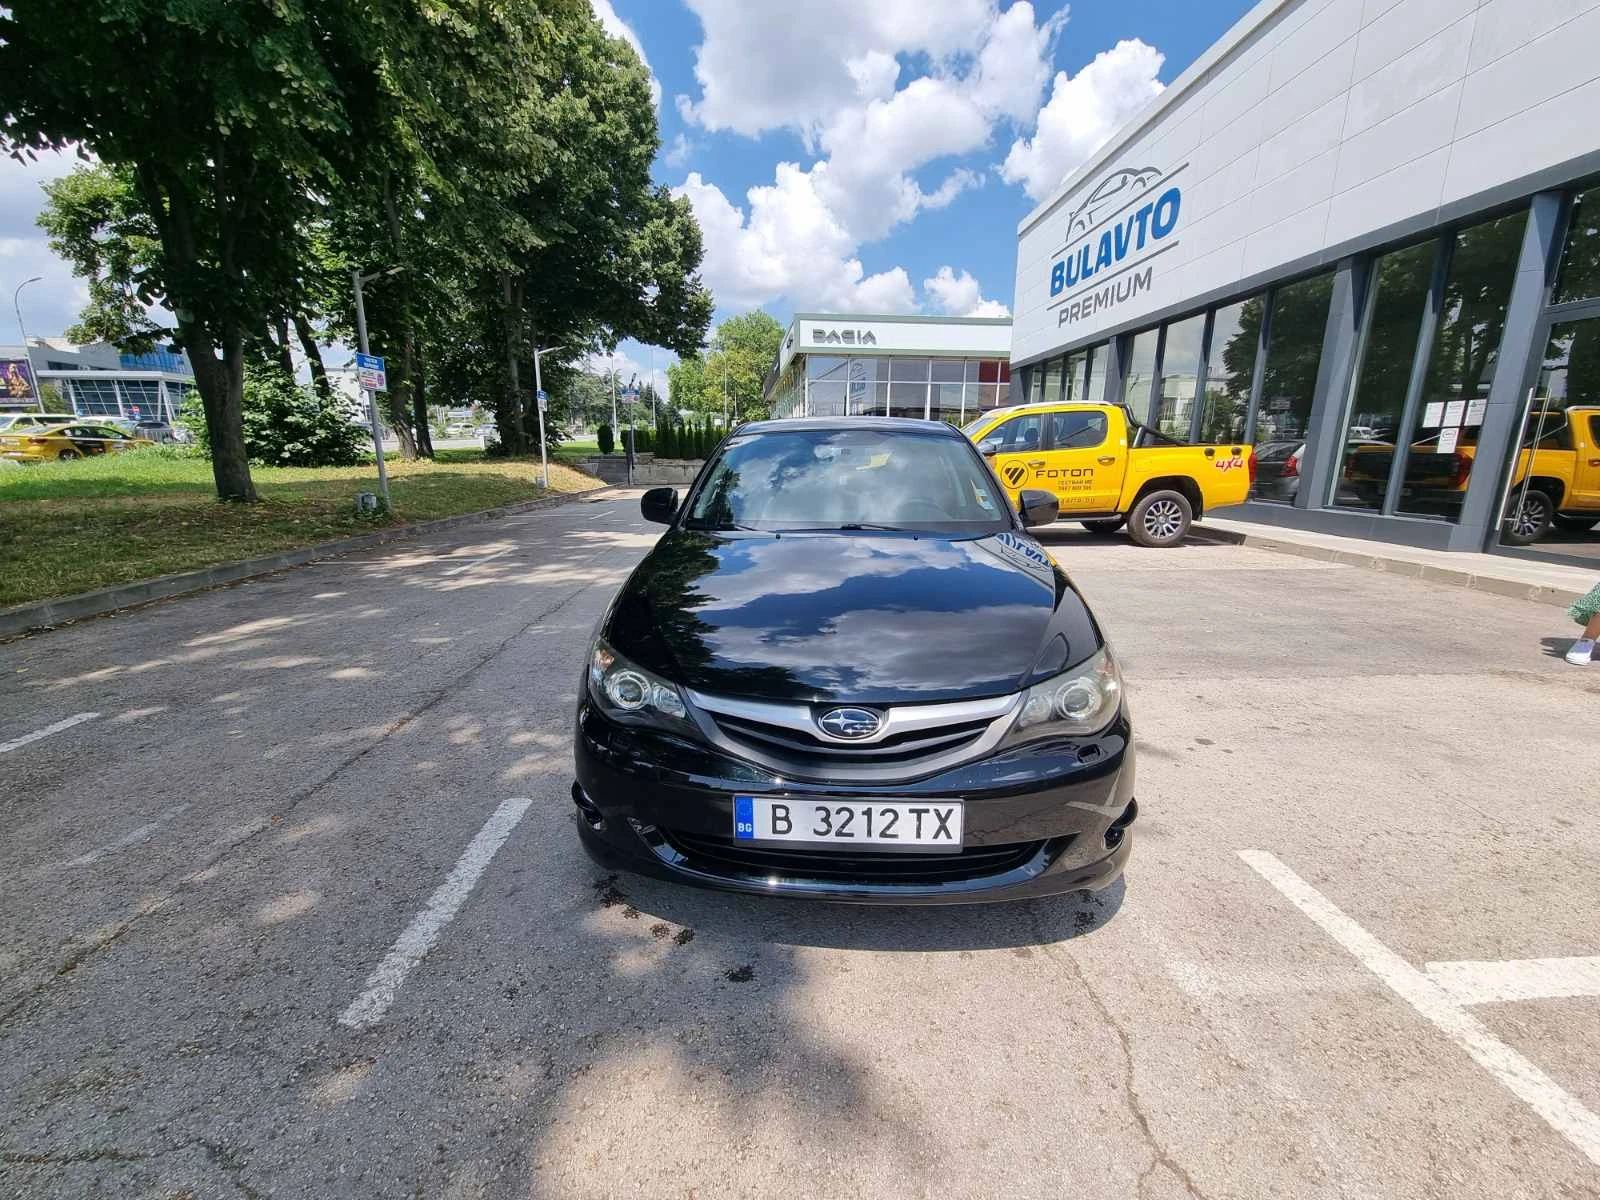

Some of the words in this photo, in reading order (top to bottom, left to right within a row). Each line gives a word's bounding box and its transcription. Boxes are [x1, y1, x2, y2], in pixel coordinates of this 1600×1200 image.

[1050, 187, 1181, 297] BULAVTO
[1058, 266, 1153, 328] PREMIUM
[812, 329, 877, 345] DACIA
[1036, 468, 1094, 478] FOTON
[737, 822, 753, 833] BG
[771, 804, 793, 835] B
[813, 806, 899, 838] 3212
[908, 808, 954, 839] TX
